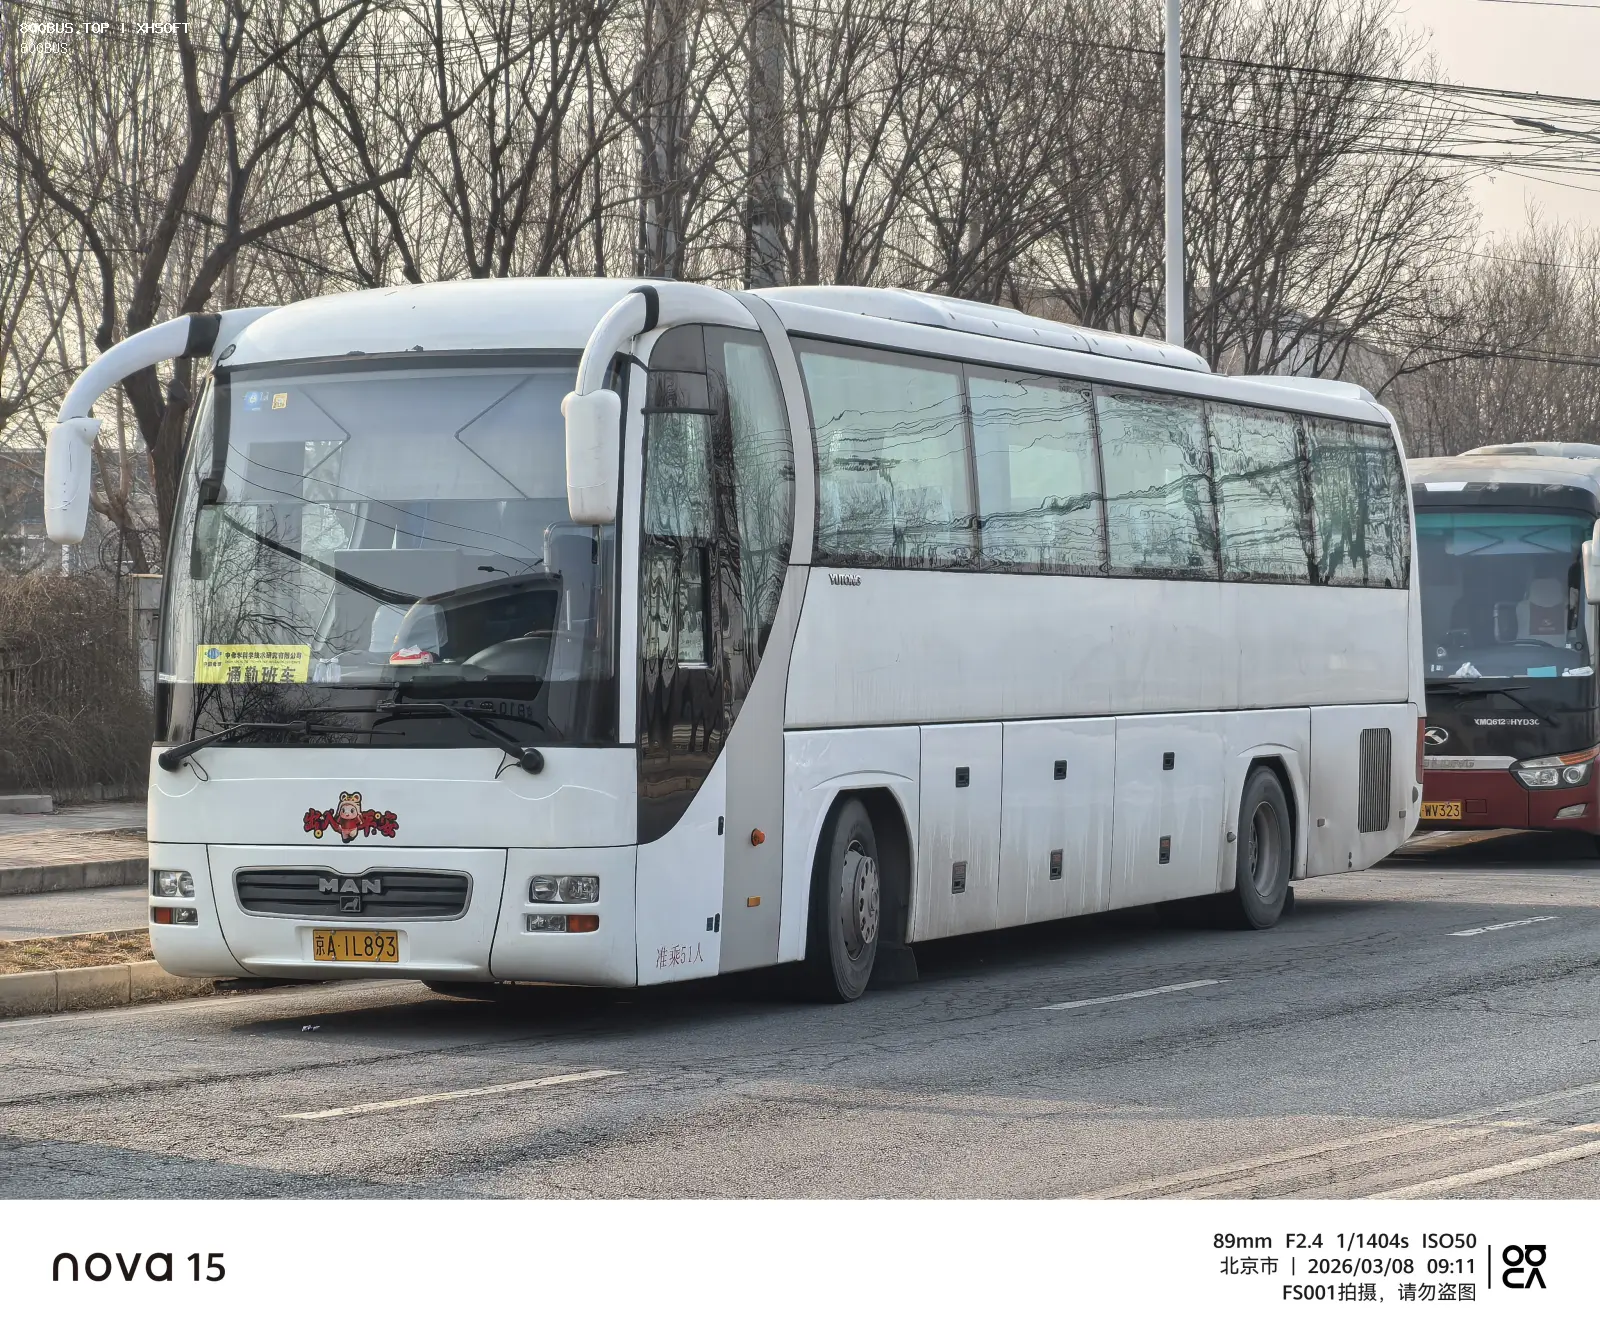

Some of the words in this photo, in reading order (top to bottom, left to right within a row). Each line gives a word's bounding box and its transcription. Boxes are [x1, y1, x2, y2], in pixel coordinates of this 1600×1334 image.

[226, 666, 297, 684] 通勤班车
[303, 807, 399, 839] 出入平安
[319, 878, 382, 894] MAN
[655, 941, 704, 970] 准乘51人
